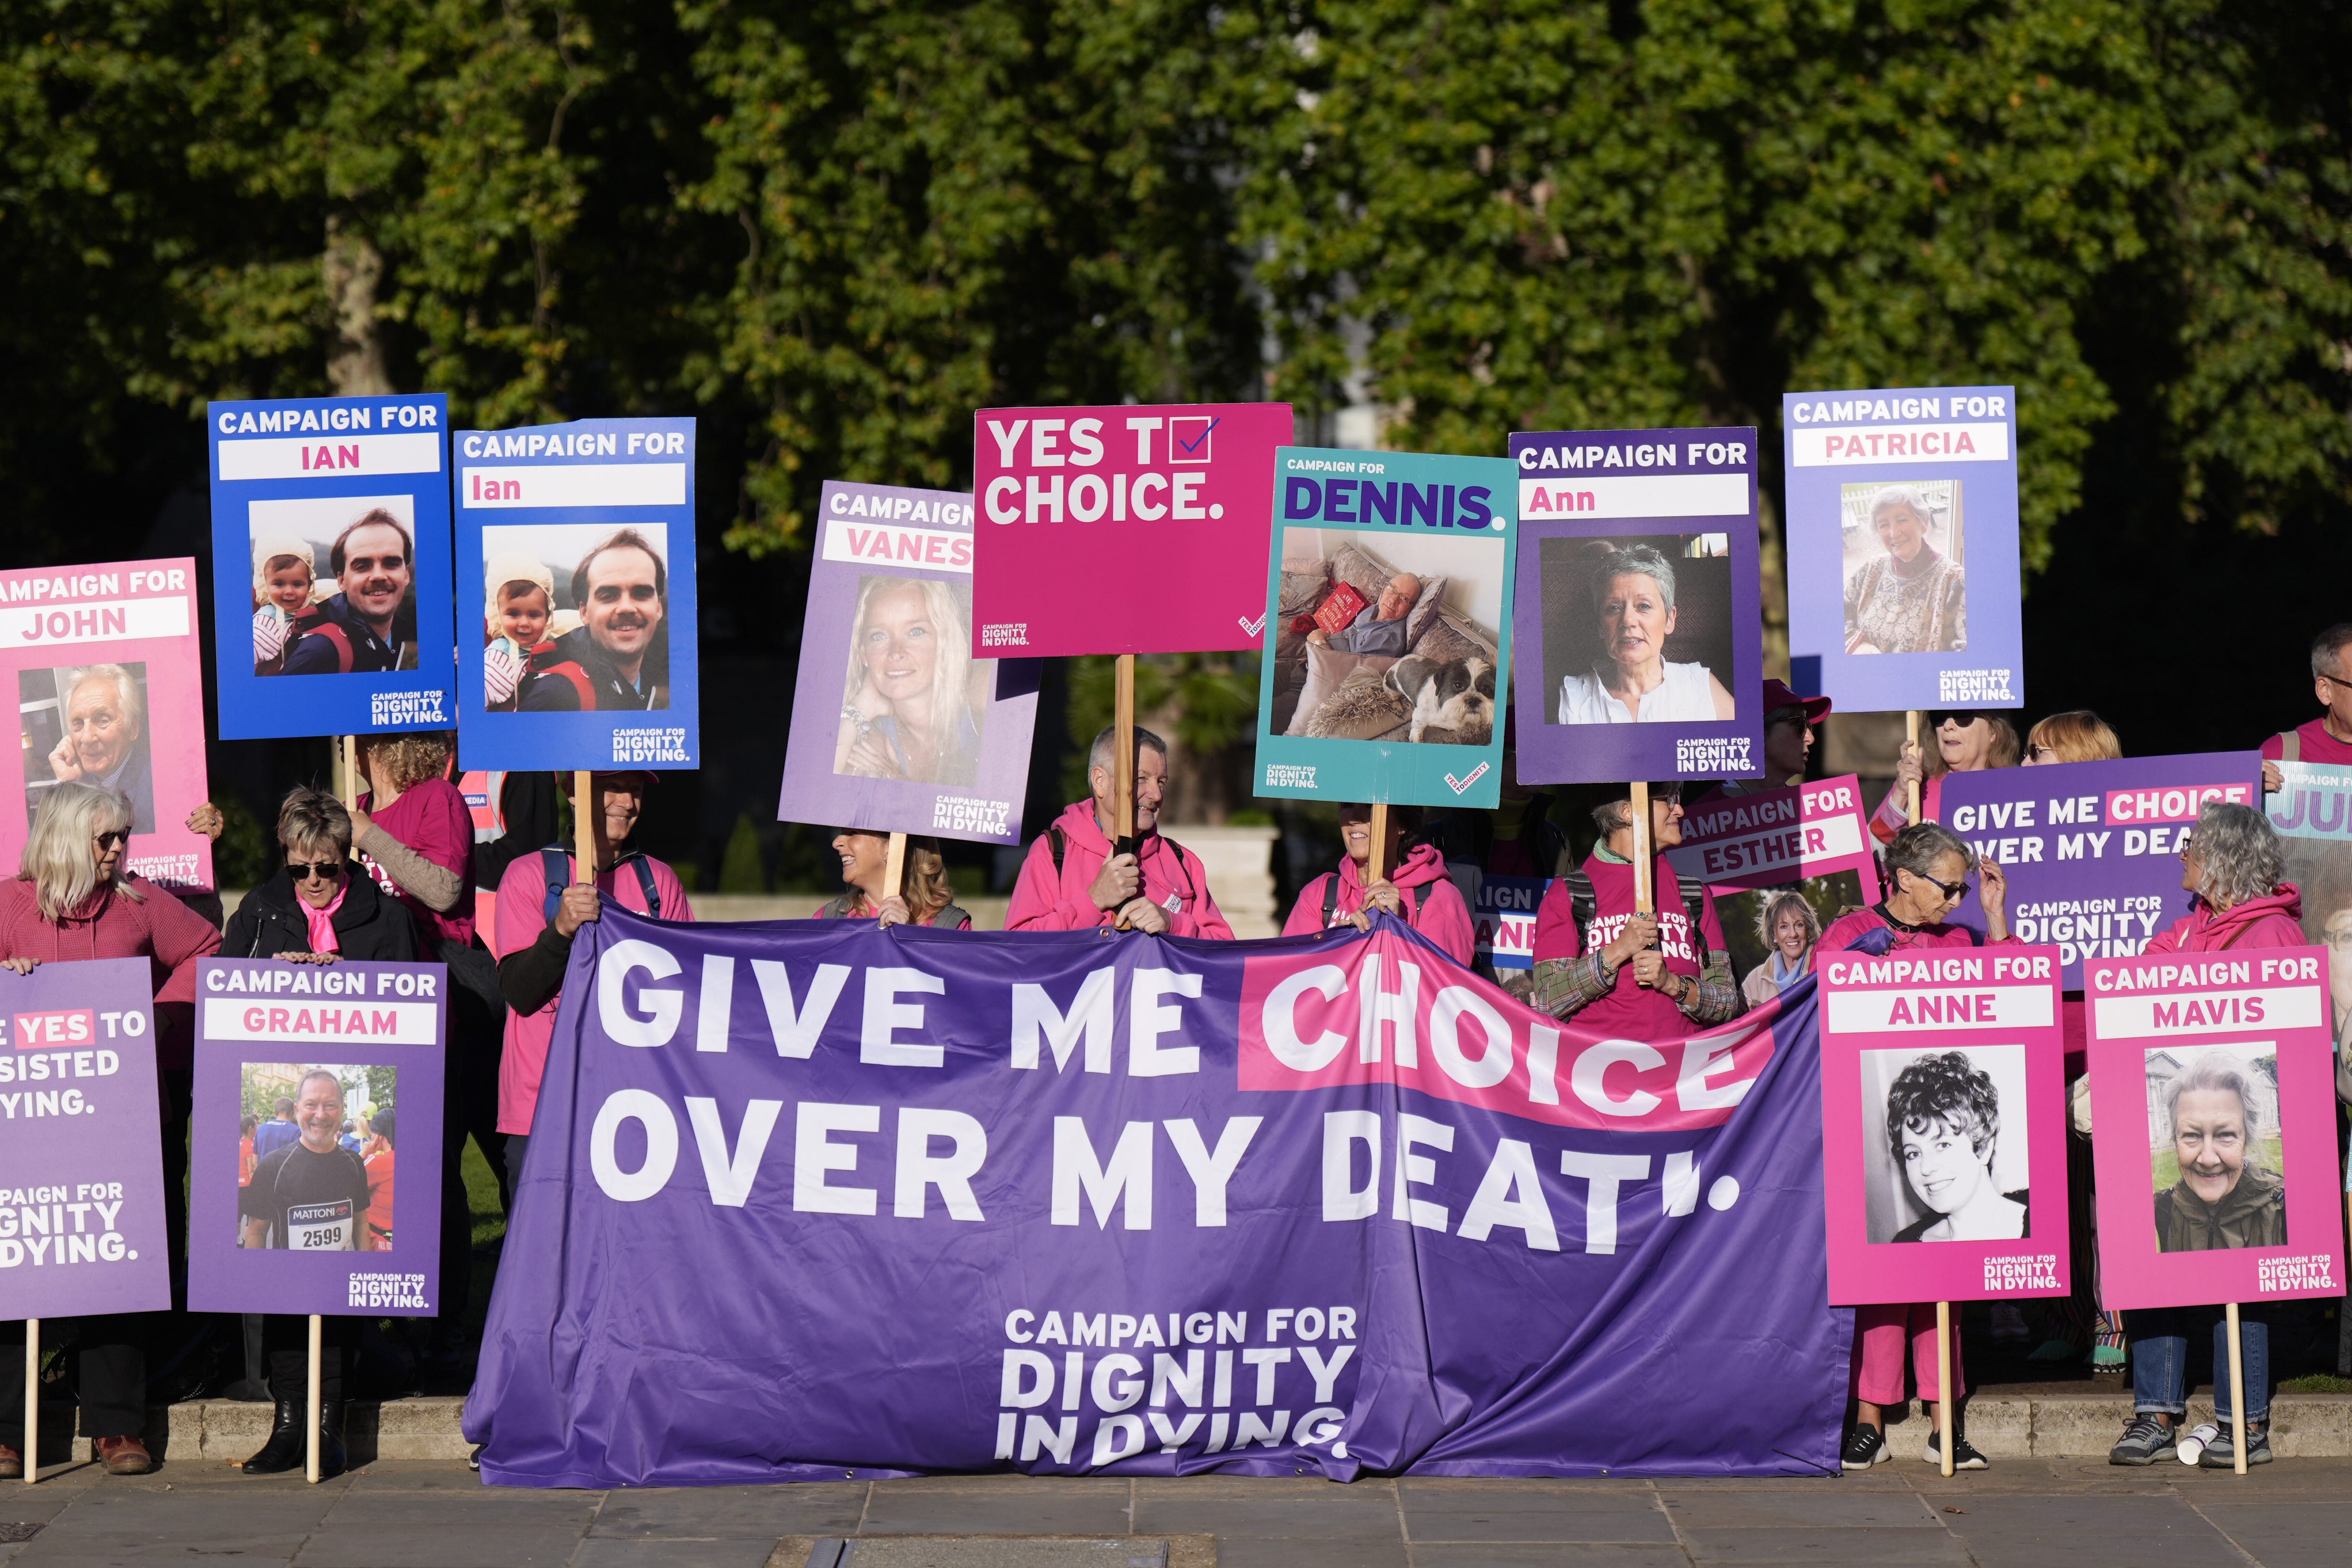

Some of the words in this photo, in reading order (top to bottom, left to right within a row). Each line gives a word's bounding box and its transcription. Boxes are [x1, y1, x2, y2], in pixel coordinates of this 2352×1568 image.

[218, 408, 370, 434] CAMPAIGN
[382, 405, 437, 428] FOR
[1793, 398, 1940, 423] CAMPAIGN
[1950, 397, 2006, 417] FOR
[463, 433, 616, 458] CAMPAIGN
[627, 432, 685, 455] FOR
[986, 418, 1104, 468] YES
[1825, 431, 1976, 458] PATRICIA
[302, 445, 360, 470] IAN
[1287, 459, 1355, 473] CAMPAIGN
[1359, 462, 1385, 474] FOR
[1519, 443, 1677, 470] CAMPAIGN
[1688, 442, 1747, 466] FOR
[473, 475, 520, 500] Ian
[984, 471, 1224, 526] CHOICE.
[1529, 486, 1595, 512] Ann
[1284, 476, 1506, 531] DENNIS.
[130, 569, 186, 593] FOR
[21, 608, 126, 640] JOHN
[982, 628, 1027, 638] DIGNITY
[1241, 618, 1252, 631] YES
[982, 638, 993, 647] IN
[994, 637, 1029, 646] DYING.
[1940, 676, 2010, 689] DIGNITY
[372, 691, 420, 701] CAMPAIGN
[372, 697, 442, 713] DIGNITY
[1940, 690, 1957, 702] IN
[1960, 688, 2015, 701] DYING.
[372, 713, 389, 725] IN
[392, 710, 448, 725] DYING.
[613, 736, 685, 749] DIGNITY
[1677, 738, 1727, 747] CAMPAIGN
[1731, 737, 1750, 745] FOR
[1677, 745, 1750, 760] DIGNITY
[613, 749, 630, 762] IN
[633, 749, 690, 762] DYING.
[1677, 760, 1695, 772] IN
[1698, 758, 1756, 772] DYING.
[1266, 777, 1278, 786] IN
[1280, 778, 1318, 789] DYING.
[1267, 769, 1315, 780] DIGNITY
[1447, 775, 1458, 788] YES
[934, 803, 1009, 823] DIGNITY
[936, 795, 987, 808] CAMPAIGN
[990, 801, 1010, 810] FOR
[1681, 798, 1795, 840] AMPAIGN
[1802, 787, 1853, 815] FOR
[1953, 801, 2035, 832] GIVE
[2048, 796, 2098, 824] ME
[2271, 791, 2352, 833] JU
[932, 815, 951, 829] IN
[953, 818, 1011, 836] DYING.
[1703, 828, 1827, 874] ESTHER
[1962, 837, 2043, 864] VER
[2057, 831, 2111, 861] MY
[127, 855, 176, 866] CAMPAIGN
[1662, 912, 1688, 926] FOR
[2016, 899, 2116, 918] CAMPAIGN
[2124, 896, 2162, 911] FOR
[1475, 920, 1536, 950] ANE
[2016, 911, 2161, 943] DIGNITY
[206, 969, 366, 995] CAMPAIGN
[377, 973, 436, 997] FOR
[1828, 959, 1983, 985] CAMPAIGN
[1996, 957, 2051, 980] FOR
[2094, 961, 2249, 992] CAMPAIGN
[2261, 958, 2318, 982] FOR
[243, 1007, 397, 1036] GRAHAM
[1888, 994, 1997, 1025] ANNE
[2154, 996, 2265, 1028] MAVIS
[18, 1014, 88, 1043] YES
[100, 1010, 146, 1038] TO
[598, 938, 946, 1068] GIVE
[1011, 966, 1203, 1077] ME
[1262, 953, 1760, 1117] CHOICE
[0, 1050, 119, 1083] SISTED
[0, 1089, 95, 1119] YING.
[590, 1088, 987, 1222] OVER
[1051, 1116, 1264, 1230] MY
[0, 1186, 68, 1206] PAIGN
[77, 1182, 123, 1201] FOR
[0, 1201, 123, 1238] GNITY
[293, 1207, 335, 1220] MATTONI
[303, 1227, 341, 1248] 2599
[1984, 1256, 2033, 1265] CAMPAIGN
[2037, 1254, 2056, 1263] FOR
[1984, 1263, 2056, 1278] DIGNITY
[2258, 1256, 2308, 1266] CAMPAIGN
[2312, 1254, 2331, 1263] FOR
[2258, 1263, 2331, 1279] DIGNITY
[349, 1273, 402, 1282] CAMPAIGN
[405, 1274, 425, 1282] FOR
[349, 1281, 425, 1295] DIGNITY
[1984, 1278, 2001, 1291] IN
[2005, 1276, 2061, 1290] DYING.
[2259, 1279, 2277, 1292] IN
[2280, 1275, 2337, 1291] DYING.
[349, 1294, 366, 1307] IN
[370, 1294, 429, 1308] DYING.
[1005, 1309, 1247, 1348] CAMPAIGN
[1266, 1306, 1357, 1342] FOR
[1000, 1345, 1357, 1413] DIGNITY
[994, 1411, 1078, 1465] IN
[1091, 1407, 1348, 1466] DYING.
